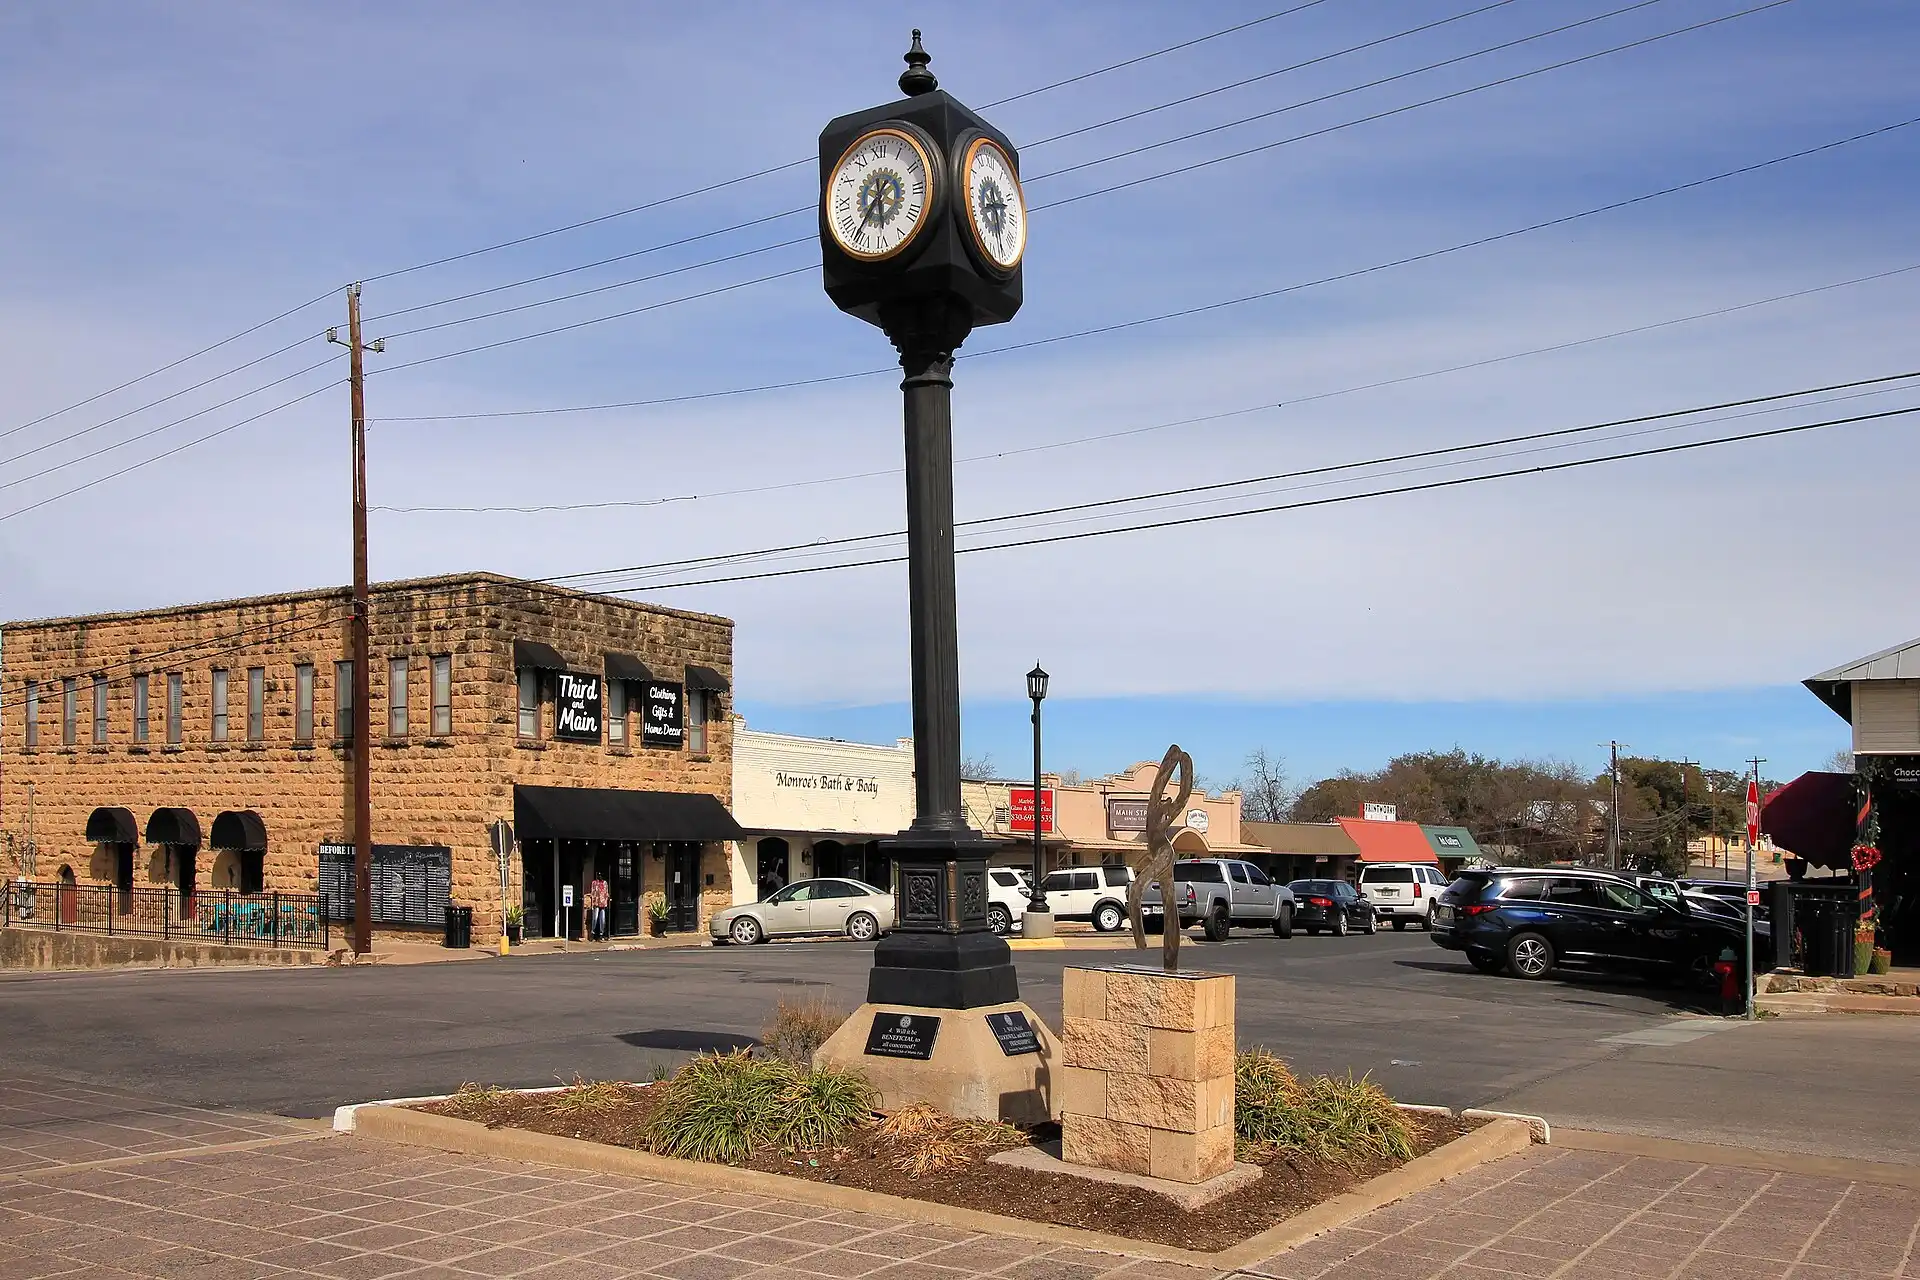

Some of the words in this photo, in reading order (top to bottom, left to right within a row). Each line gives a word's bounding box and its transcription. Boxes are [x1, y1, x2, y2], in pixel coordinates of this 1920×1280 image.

[559, 674, 598, 700] Third
[649, 686, 677, 704] Clothing
[571, 700, 585, 709] and
[652, 704, 667, 721] Gifts
[668, 706, 674, 719] &
[558, 707, 598, 732] Main
[644, 722, 663, 735] Home
[663, 723, 683, 737] Decor
[776, 772, 817, 789] Monroe's
[820, 775, 842, 791] Bath
[844, 777, 855, 791] &
[856, 777, 879, 800] Body
[1135, 809, 1148, 817] STR
[1747, 801, 1758, 826] STOP
[319, 846, 346, 855] BEFORE
[881, 1034, 915, 1043] BENEFICIAL
